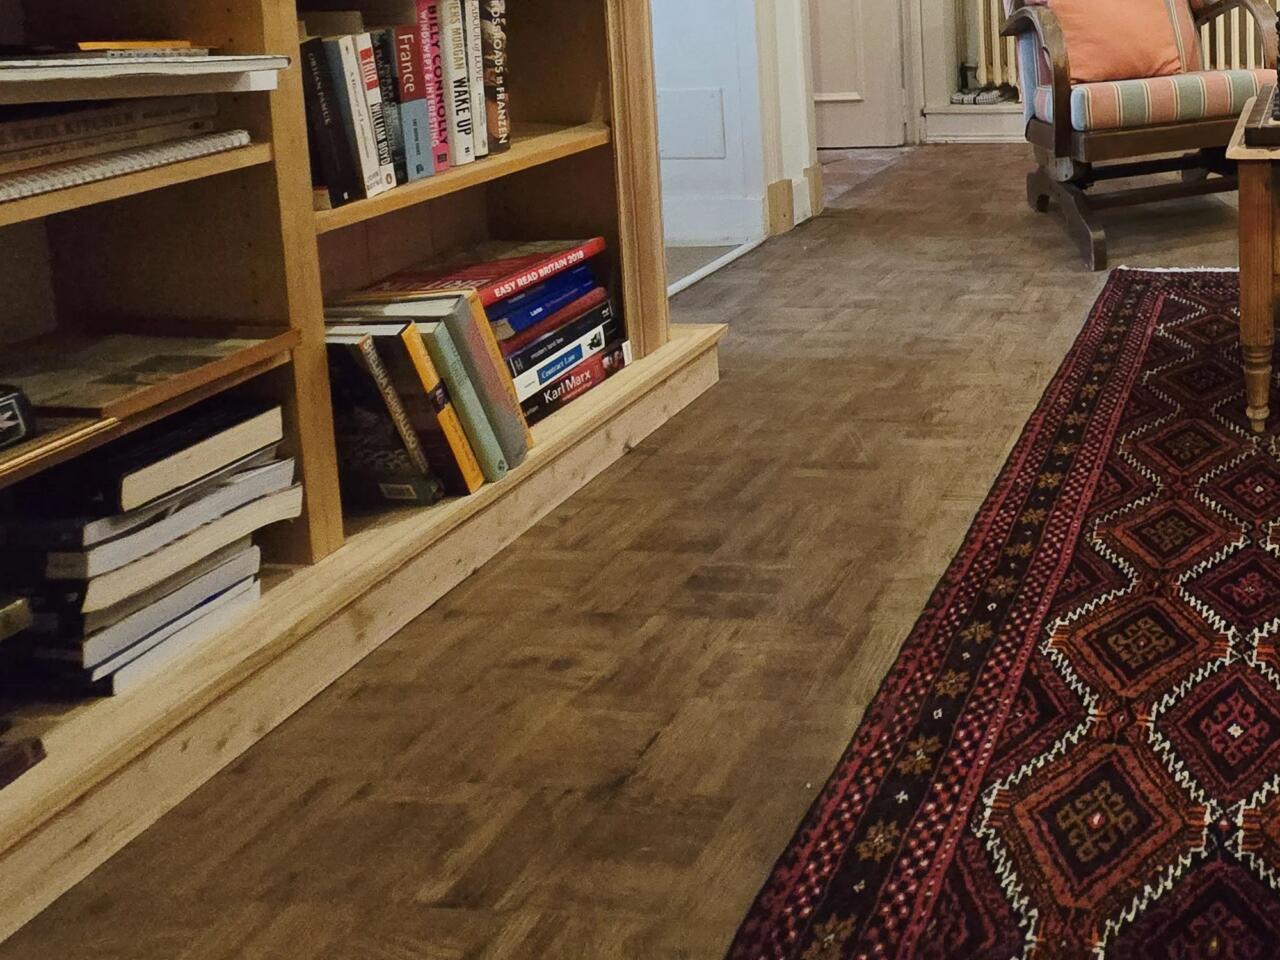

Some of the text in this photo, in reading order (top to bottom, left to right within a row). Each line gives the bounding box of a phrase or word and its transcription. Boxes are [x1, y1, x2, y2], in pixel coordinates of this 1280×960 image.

[398, 34, 416, 93] France
[419, 9, 432, 75] WINDSWEPT
[451, 25, 466, 71] MORGAN
[307, 52, 332, 127] ORHAN PAMUK
[361, 57, 378, 85] TRIO
[427, 5, 448, 145] BILLY CONNOLLY
[473, 54, 483, 83] LOVE
[425, 82, 440, 148] INTERESTING
[453, 75, 470, 116] WAKE
[496, 82, 508, 145] FRANZEN
[370, 101, 391, 166] WILLIAM BOYD
[456, 118, 473, 136] UP
[494, 250, 585, 298] EASY READ BRITAIN 2018
[363, 340, 388, 390] SHELINA
[541, 352, 578, 380] Contract Law
[543, 369, 592, 405] Karl Marx
